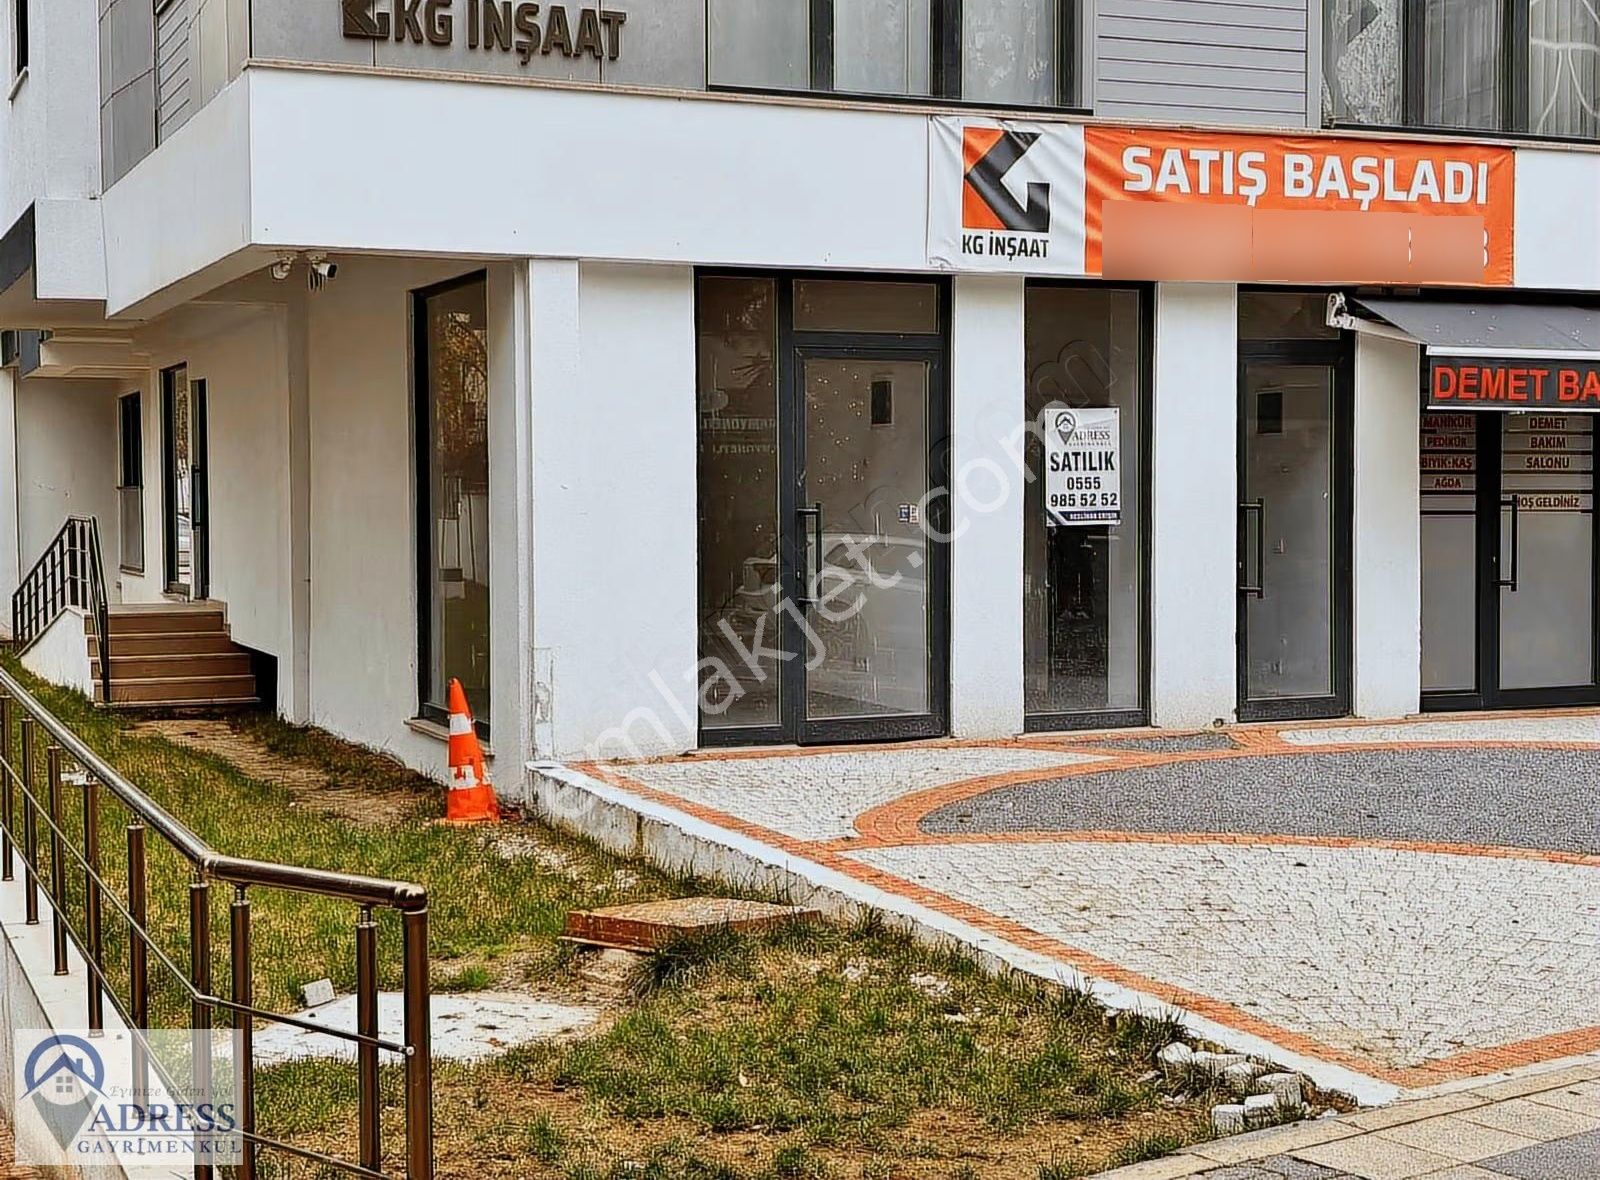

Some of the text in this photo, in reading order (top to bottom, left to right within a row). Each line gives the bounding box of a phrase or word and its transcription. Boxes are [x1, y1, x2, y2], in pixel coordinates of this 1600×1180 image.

[1121, 145, 1488, 211] SATIŞ BAŞLADI
[962, 231, 1049, 261] KG İNŞAAT
[1433, 366, 1548, 401] DEMET
[1529, 417, 1568, 430] DEMET
[1072, 430, 1111, 441] ADRESS
[1530, 437, 1566, 449] BAKIM
[1050, 451, 1115, 472] SATILIK
[1526, 457, 1570, 469] SALONU
[1066, 476, 1101, 490] 0555
[1050, 493, 1118, 507] 985 52 52
[1535, 494, 1580, 508] GELDİNİZ
